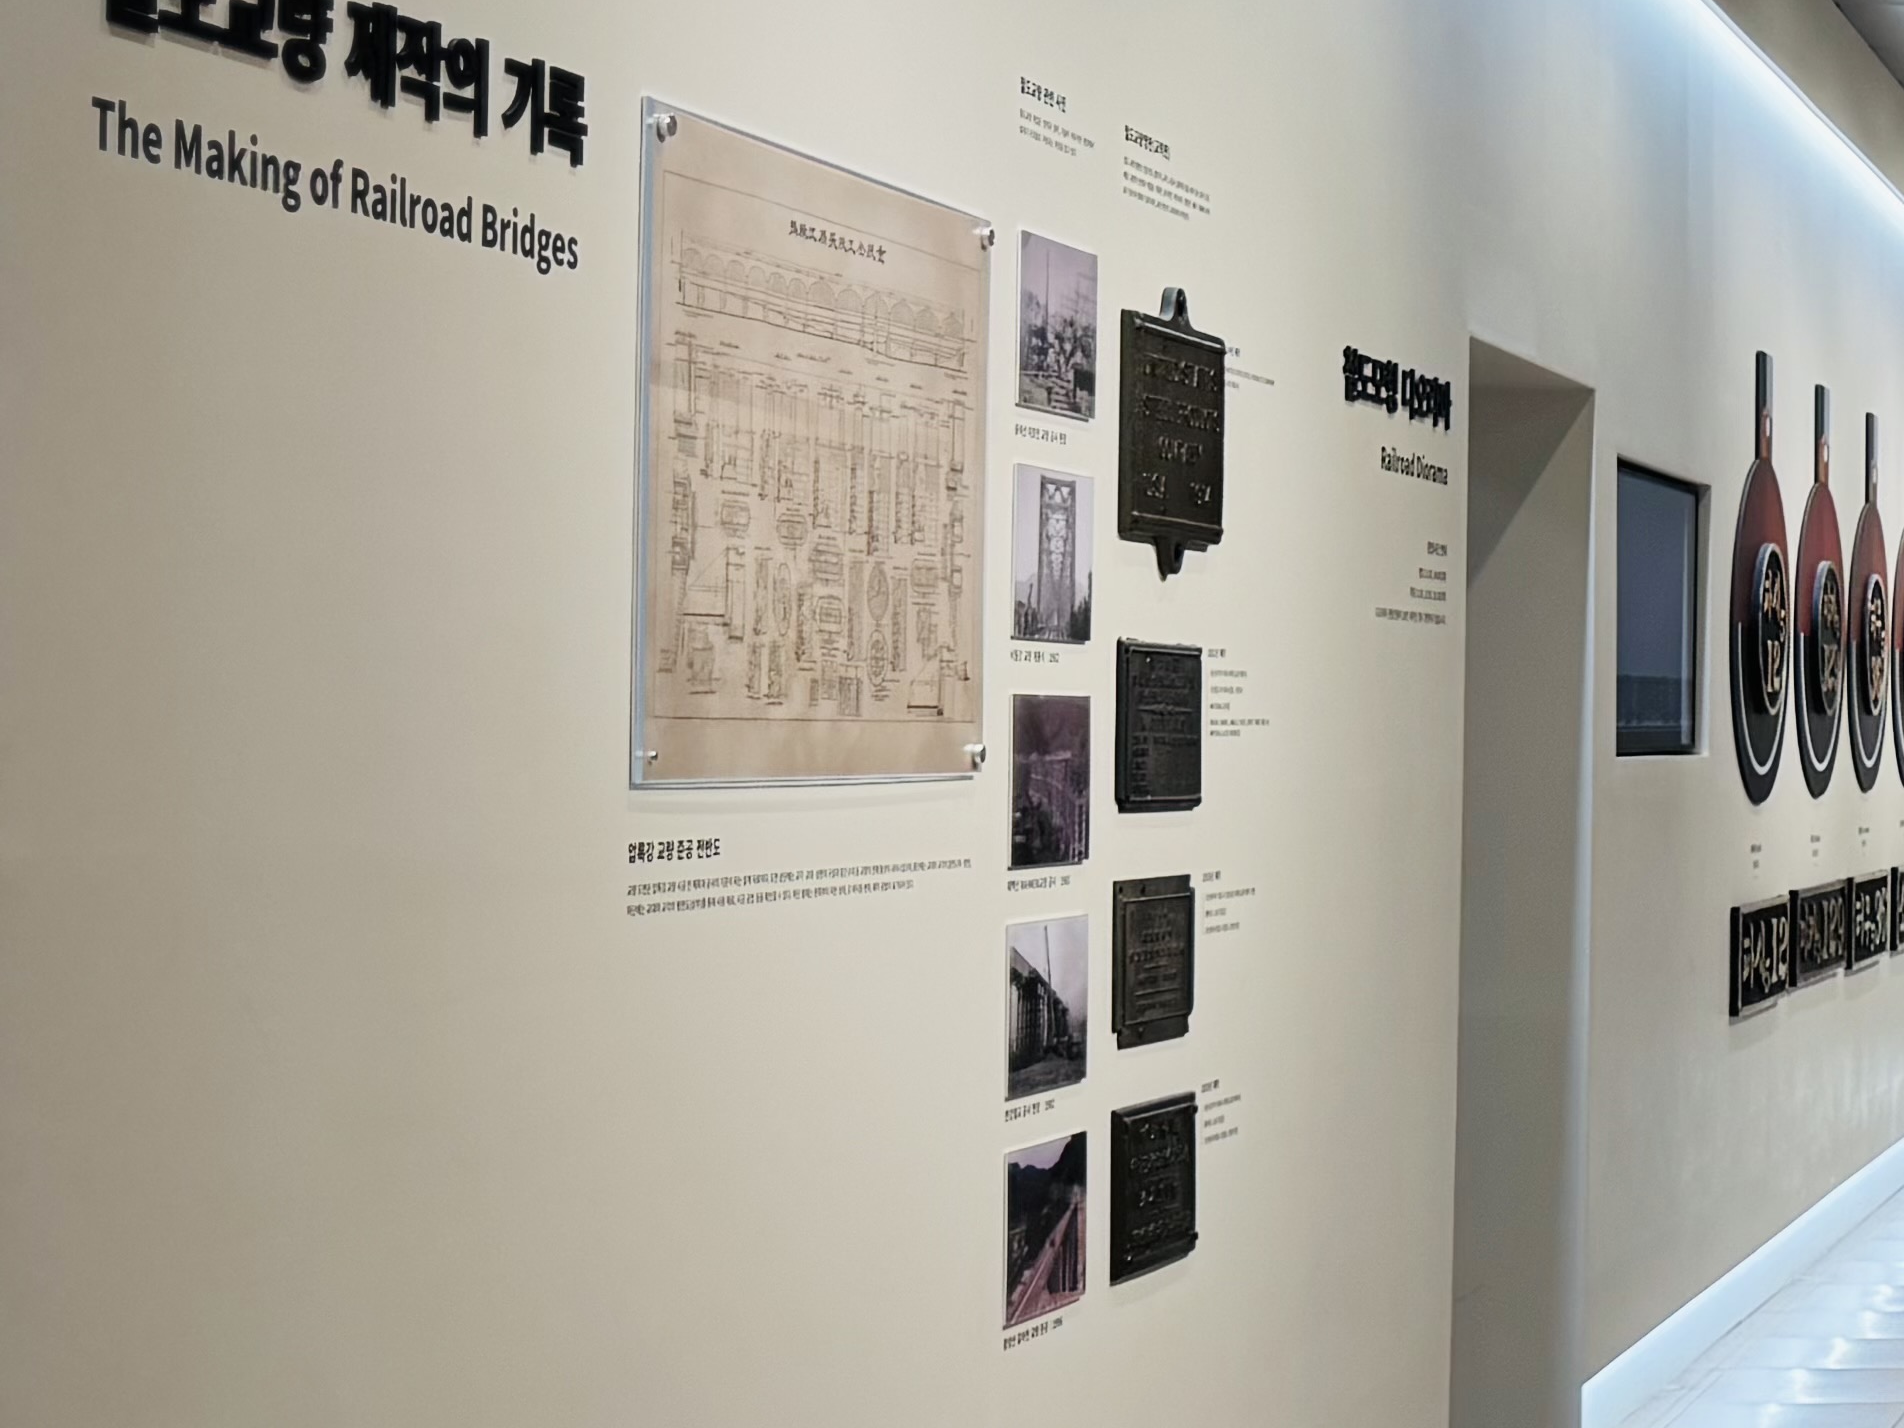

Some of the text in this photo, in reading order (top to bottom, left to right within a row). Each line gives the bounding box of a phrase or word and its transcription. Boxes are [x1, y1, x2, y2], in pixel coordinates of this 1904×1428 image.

[345, 2, 489, 139] 제작의
[502, 57, 589, 167] 기록
[92, 97, 579, 275] The Making of Railroad Bridges
[1381, 446, 1448, 485] Railroad Diorama
